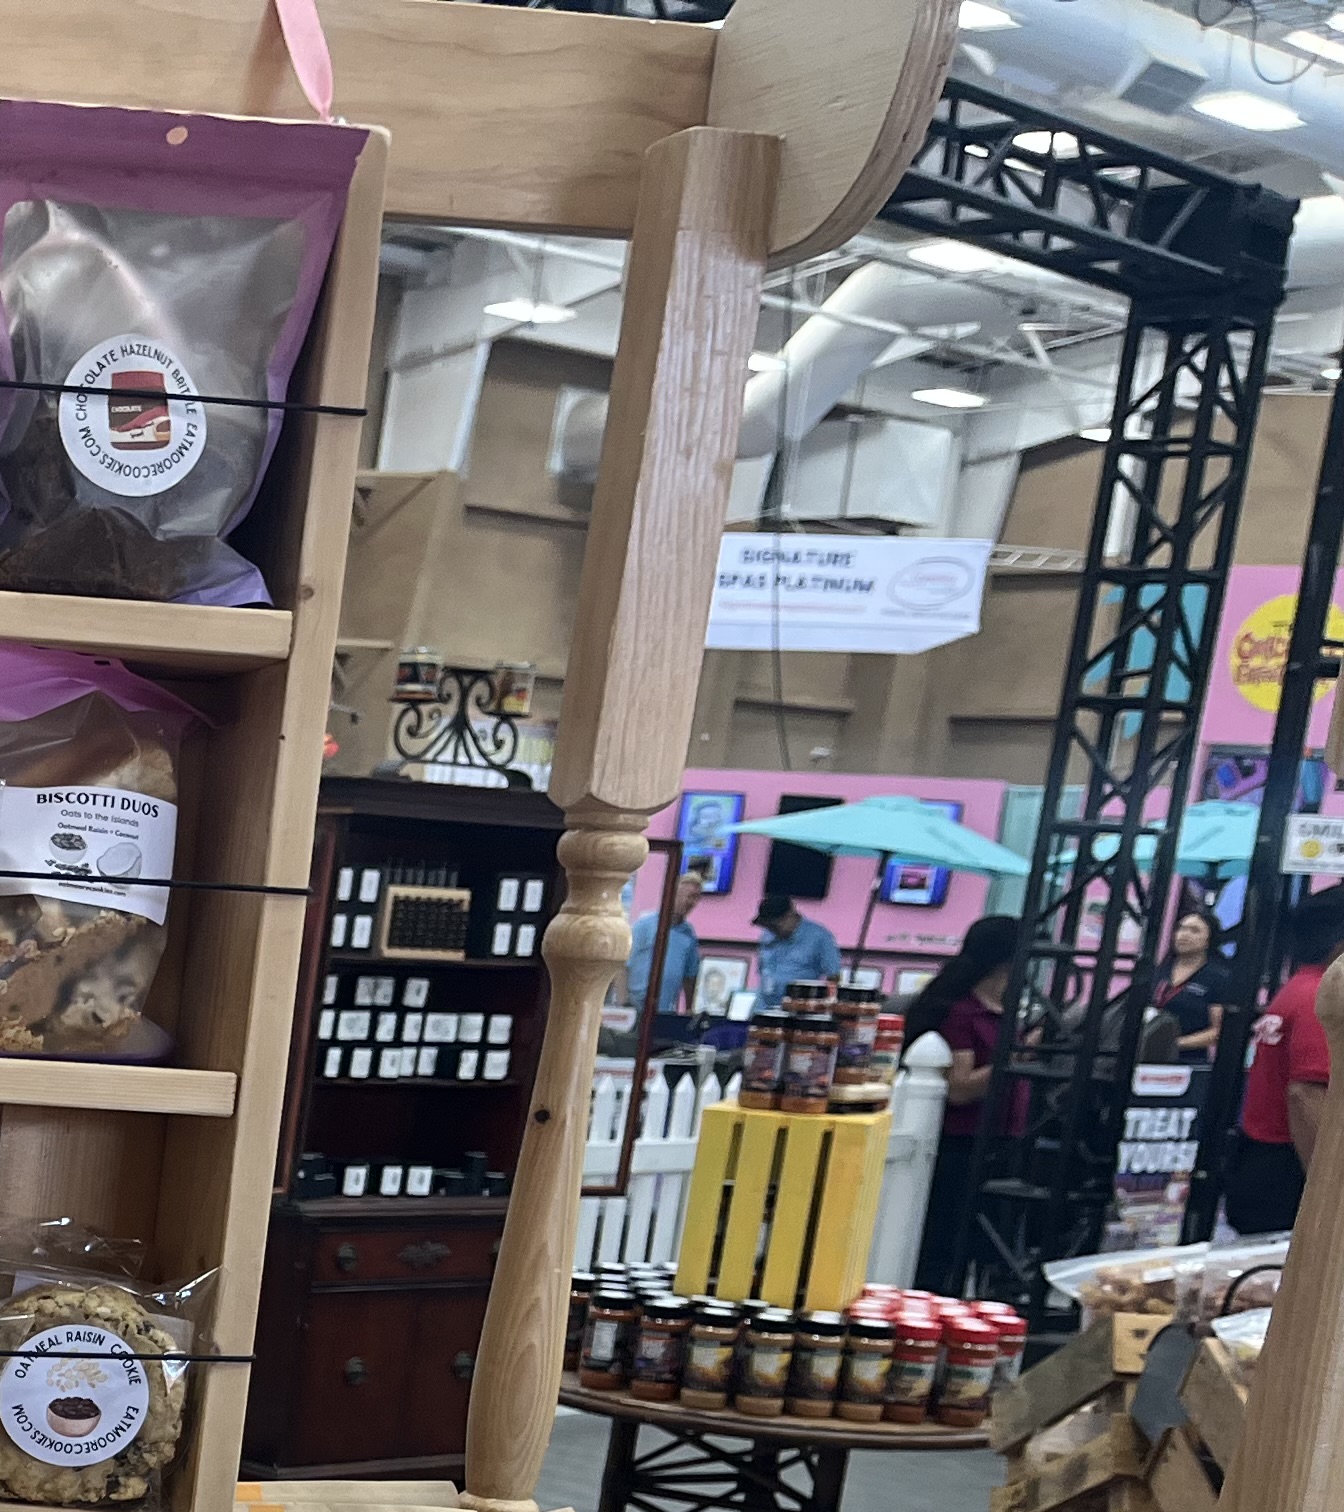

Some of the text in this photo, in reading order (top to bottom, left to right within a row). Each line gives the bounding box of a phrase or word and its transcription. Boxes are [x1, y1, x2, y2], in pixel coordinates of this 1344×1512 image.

[36, 792, 159, 818] BISCOTTI DUOS
[60, 809, 81, 818] Oats
[95, 813, 108, 821] the
[66, 1331, 106, 1347] RAISIN
[11, 1404, 139, 1455] EATMOORECOOKIES.COM
